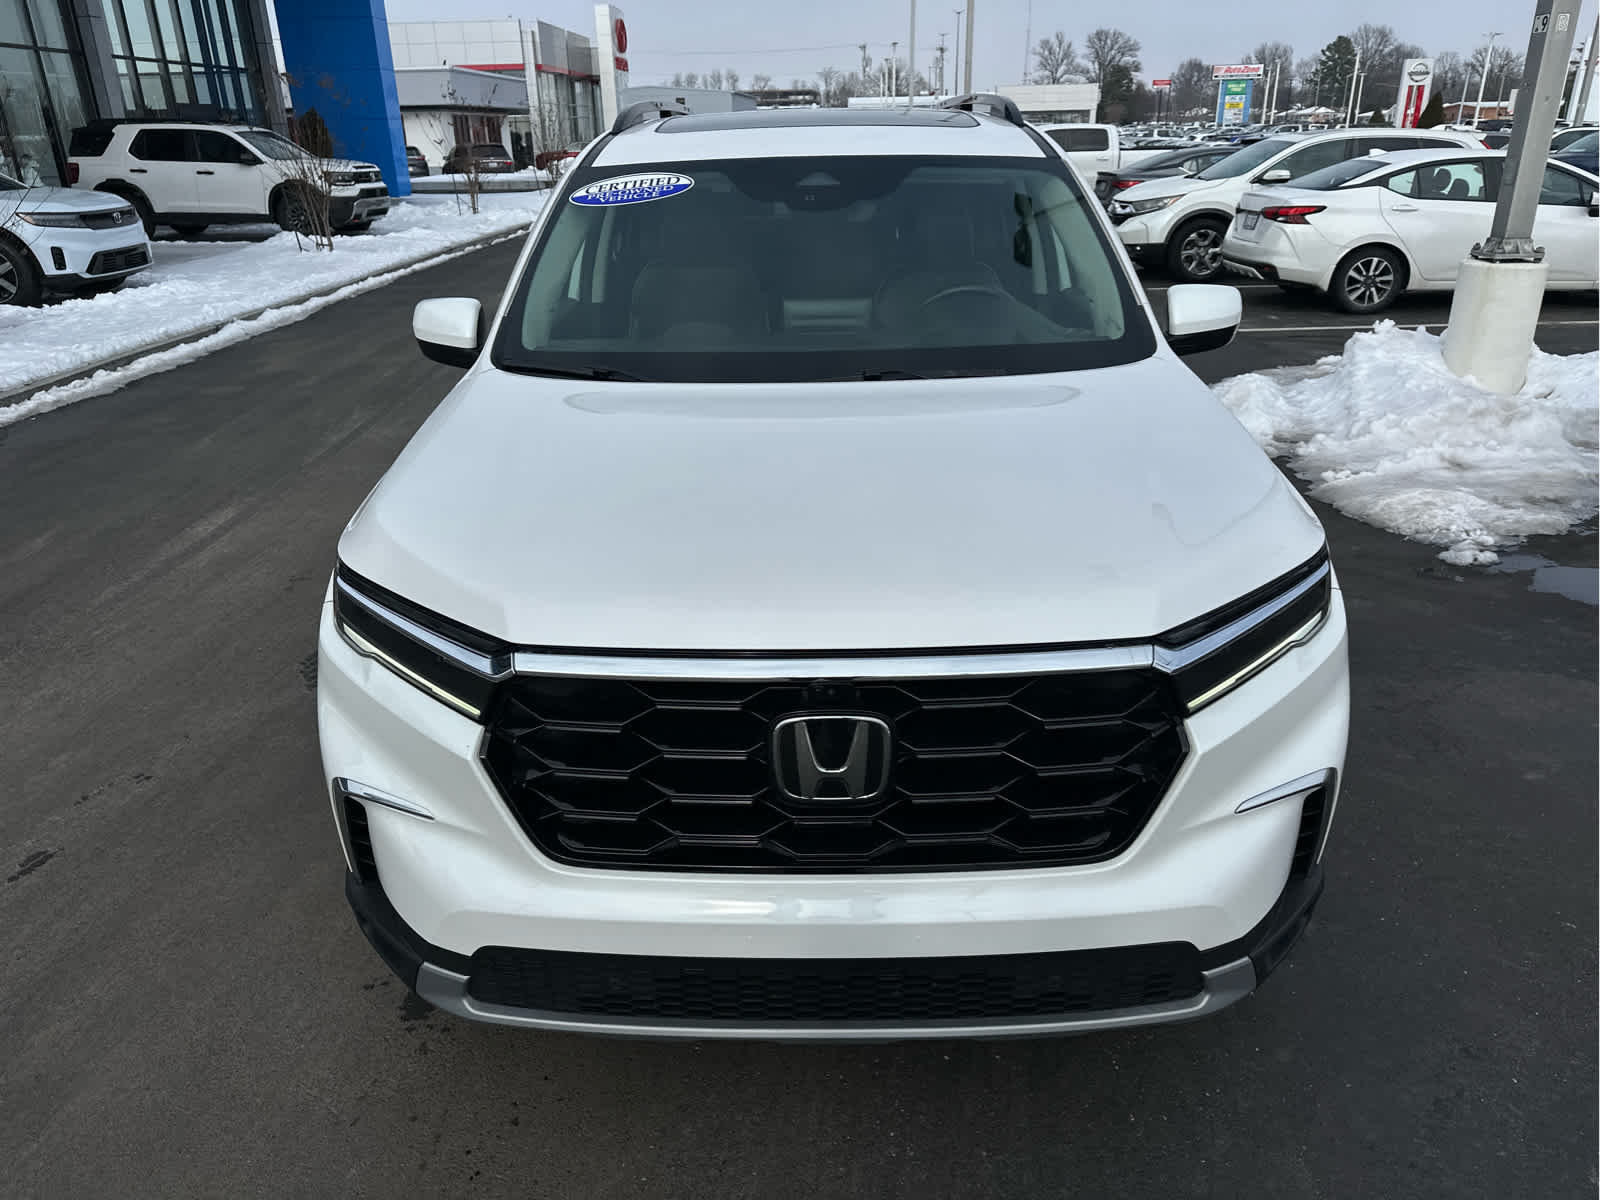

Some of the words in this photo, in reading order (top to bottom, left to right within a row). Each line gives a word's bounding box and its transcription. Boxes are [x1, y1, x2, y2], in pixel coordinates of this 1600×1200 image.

[585, 176, 681, 194] CERTIFIED
[587, 185, 674, 200] PRE-OWNED
[600, 190, 661, 202] VEHICLE
